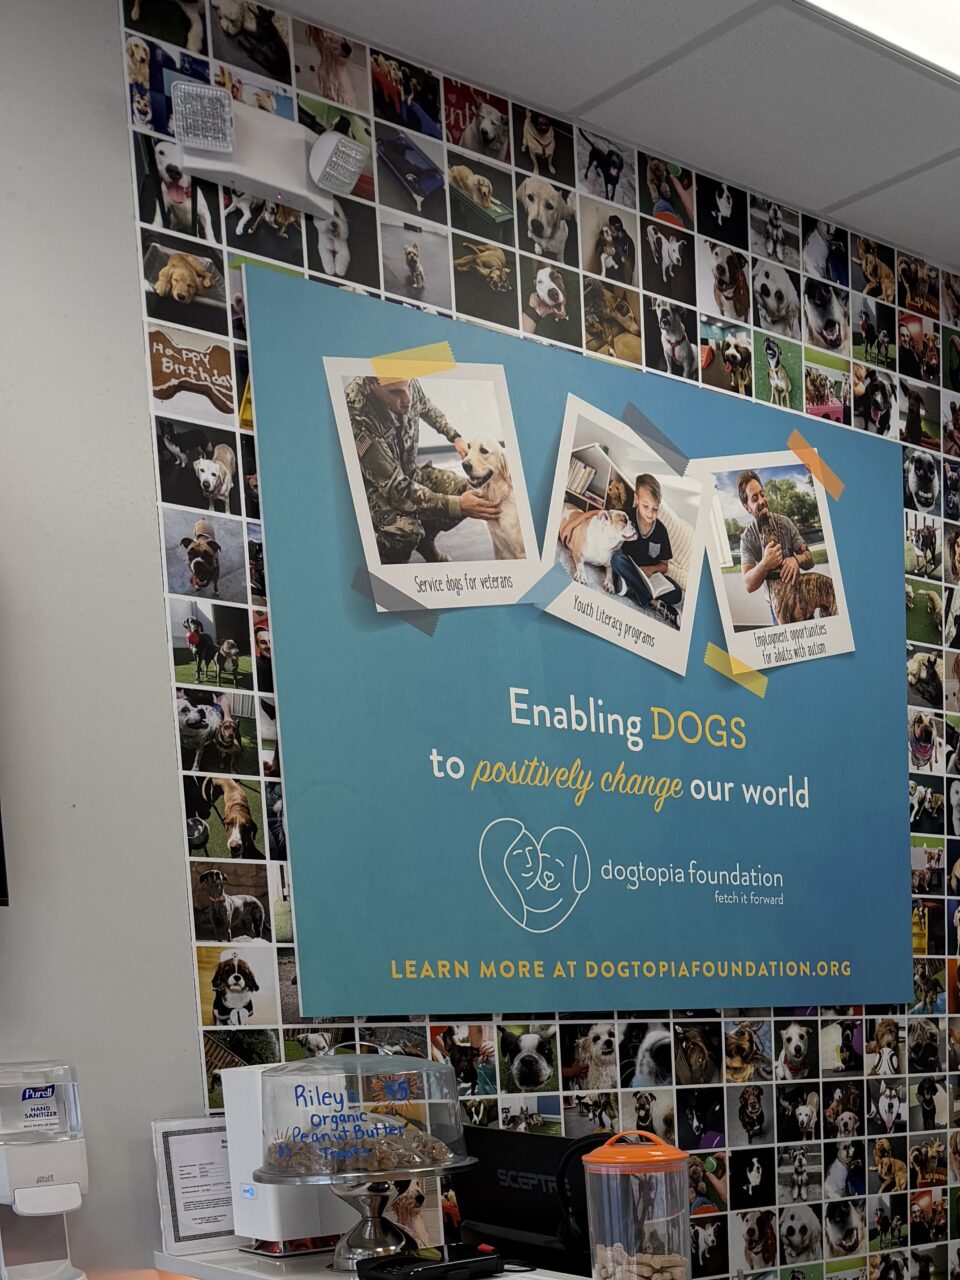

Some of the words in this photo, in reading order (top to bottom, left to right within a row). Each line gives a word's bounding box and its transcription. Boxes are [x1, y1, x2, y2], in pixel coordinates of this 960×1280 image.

[153, 342, 210, 368] Happy
[414, 574, 443, 593] Service
[446, 574, 463, 596] dogs
[464, 573, 477, 590] for
[480, 574, 513, 589] veterans
[572, 594, 594, 618] Youth
[595, 606, 623, 637] Literacy
[624, 623, 656, 648] programs
[753, 629, 789, 650] Employment
[790, 622, 827, 646] opportunities
[762, 649, 772, 665] for
[774, 647, 793, 663] adults
[794, 643, 807, 659] with
[808, 642, 827, 657] autism
[508, 687, 643, 752] Enabling
[650, 706, 747, 750] DOGS
[429, 748, 465, 779] to
[470, 756, 593, 806] positively
[600, 761, 684, 812] change
[690, 777, 735, 802] our
[742, 775, 810, 808] world
[601, 859, 685, 890] dogtopia
[688, 860, 784, 887] foundation
[714, 890, 740, 904] fetch
[741, 891, 748, 904] it
[749, 891, 784, 905] forward
[390, 959, 470, 979] LEARN
[479, 959, 545, 979] MORE
[552, 960, 577, 979] AT
[585, 960, 852, 979] DOGTOPIAFOUNDATION.ORG
[25, 1087, 52, 1099] Purell
[24, 1110, 58, 1119] SANITIZER
[30, 1105, 51, 1113] HAND
[311, 1111, 368, 1132] Organic
[292, 1126, 352, 1144] Peanut
[354, 1124, 405, 1140] Butter
